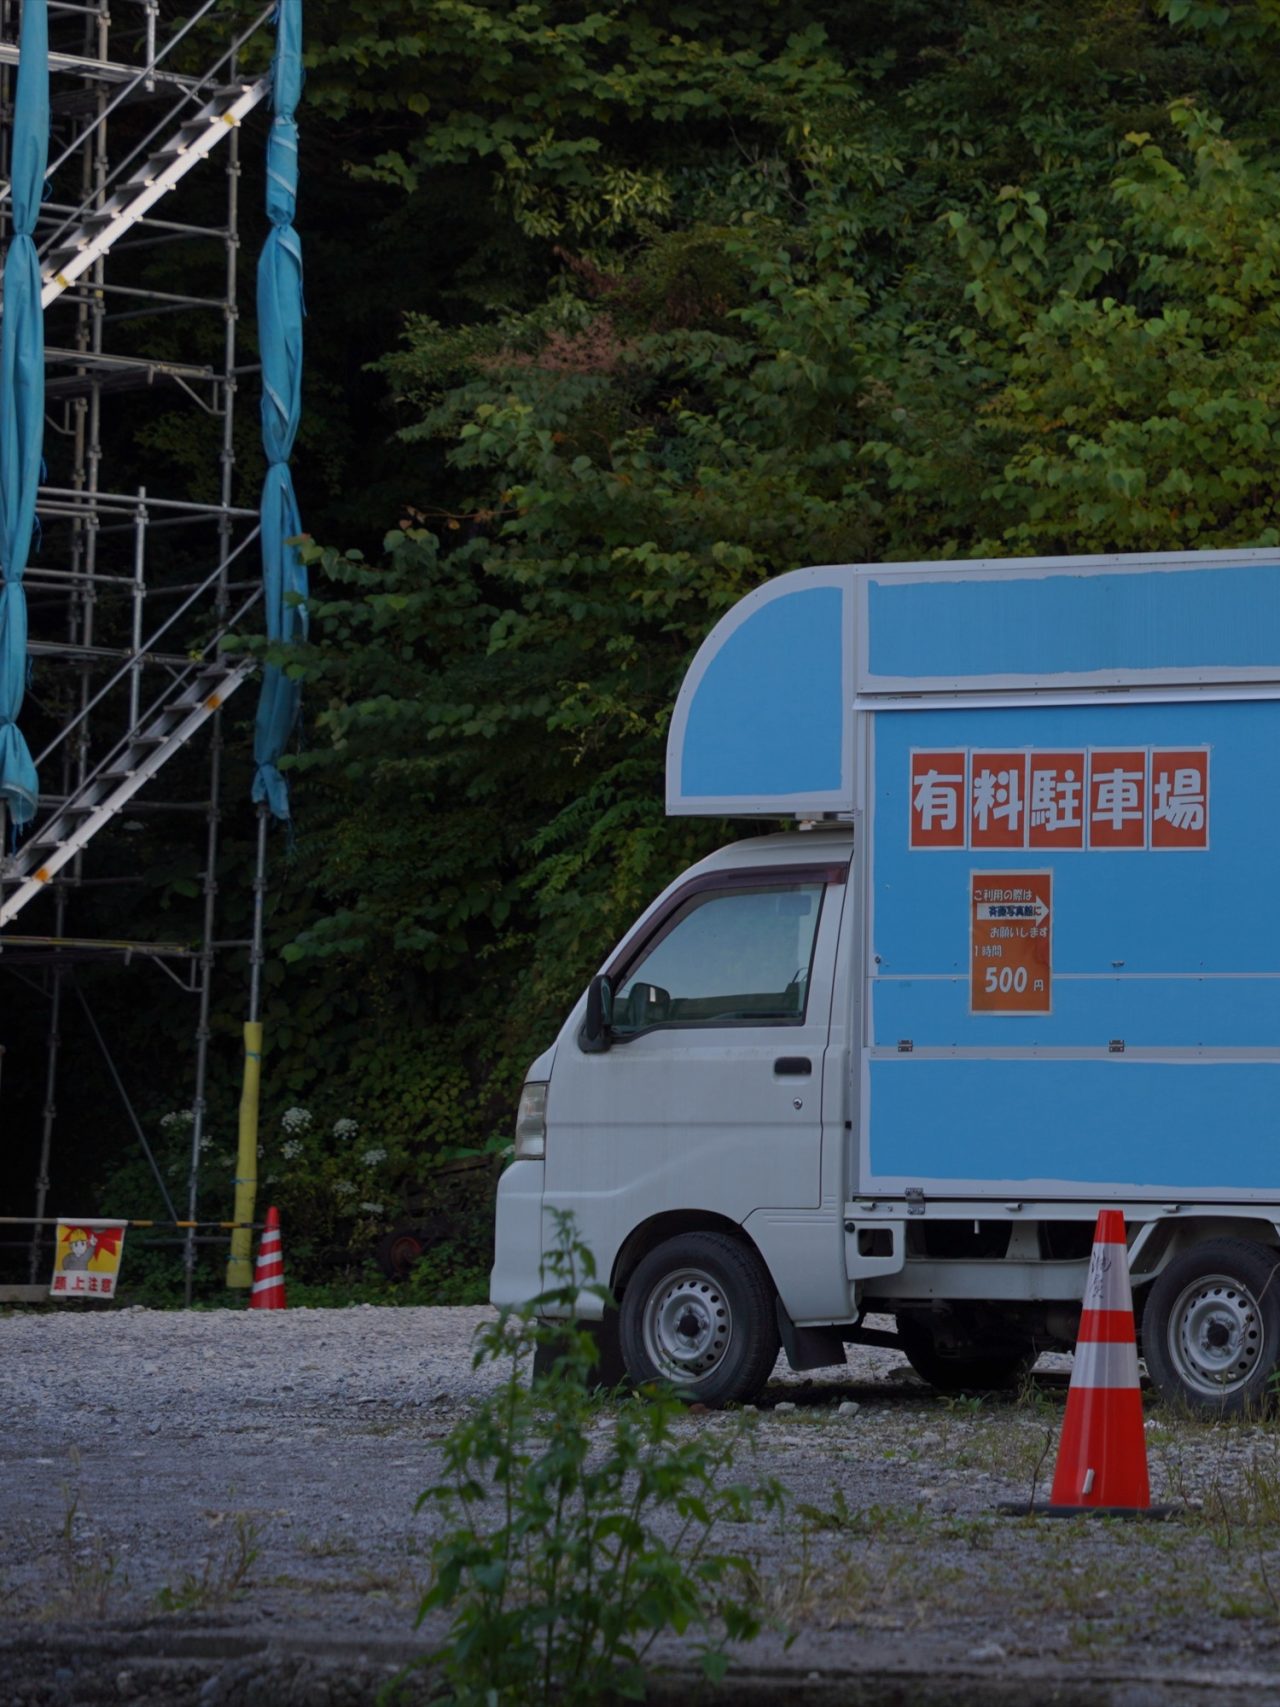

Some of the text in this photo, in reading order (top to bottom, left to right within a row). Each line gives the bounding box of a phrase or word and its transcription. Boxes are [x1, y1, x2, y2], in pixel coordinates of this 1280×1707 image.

[913, 768, 1205, 831] 有料駐車場
[974, 889, 1032, 901] ご利用の際は
[990, 927, 1048, 938] お願いします
